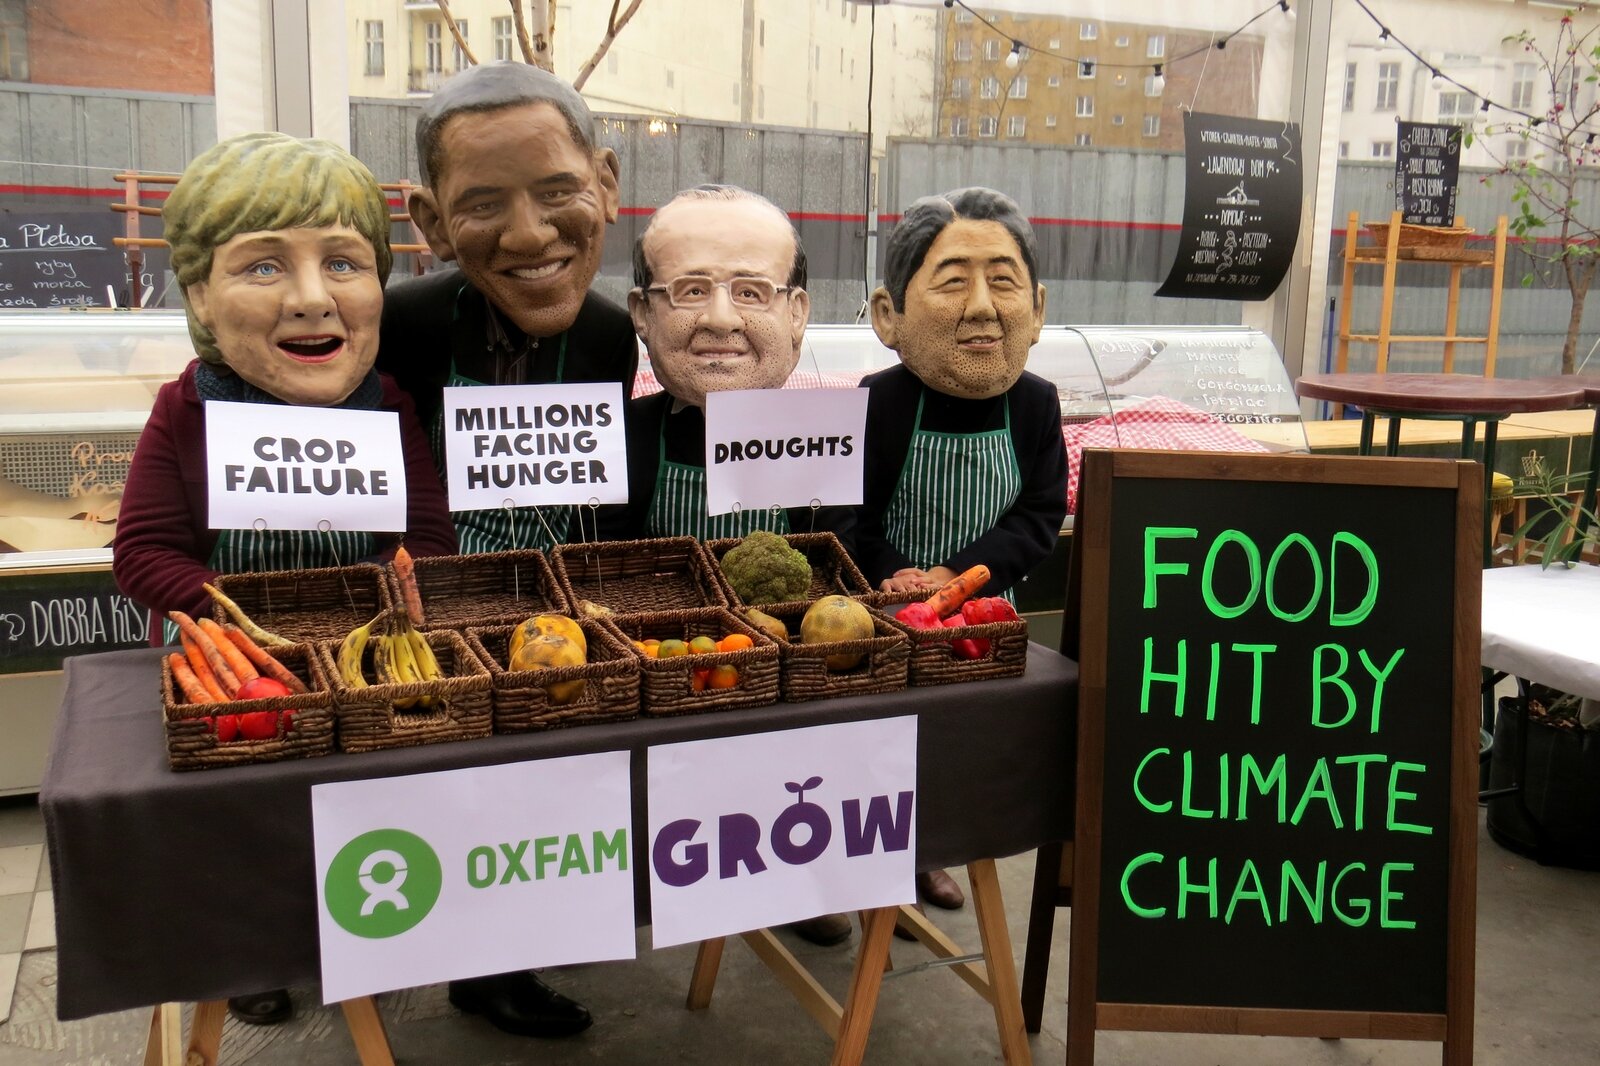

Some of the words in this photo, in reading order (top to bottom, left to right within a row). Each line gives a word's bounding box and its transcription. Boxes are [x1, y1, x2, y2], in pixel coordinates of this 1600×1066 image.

[32, 280, 92, 289] morza
[35, 259, 77, 279] ryby
[455, 402, 612, 432] MILLIONS
[253, 436, 356, 464] CROP
[474, 430, 598, 458] FACING
[714, 435, 854, 465] DROUGHTS
[225, 466, 389, 496] FAILURE
[467, 459, 608, 490] HUNGER
[1142, 526, 1379, 627] FOOD
[31, 597, 108, 647] DOBRA
[1140, 636, 1278, 725] HIT
[1311, 643, 1405, 733] BY
[1133, 747, 1433, 835] CLIMATE
[652, 777, 914, 888] GROW
[467, 829, 628, 889] OXFAM
[1120, 851, 1417, 929] CHANGE
